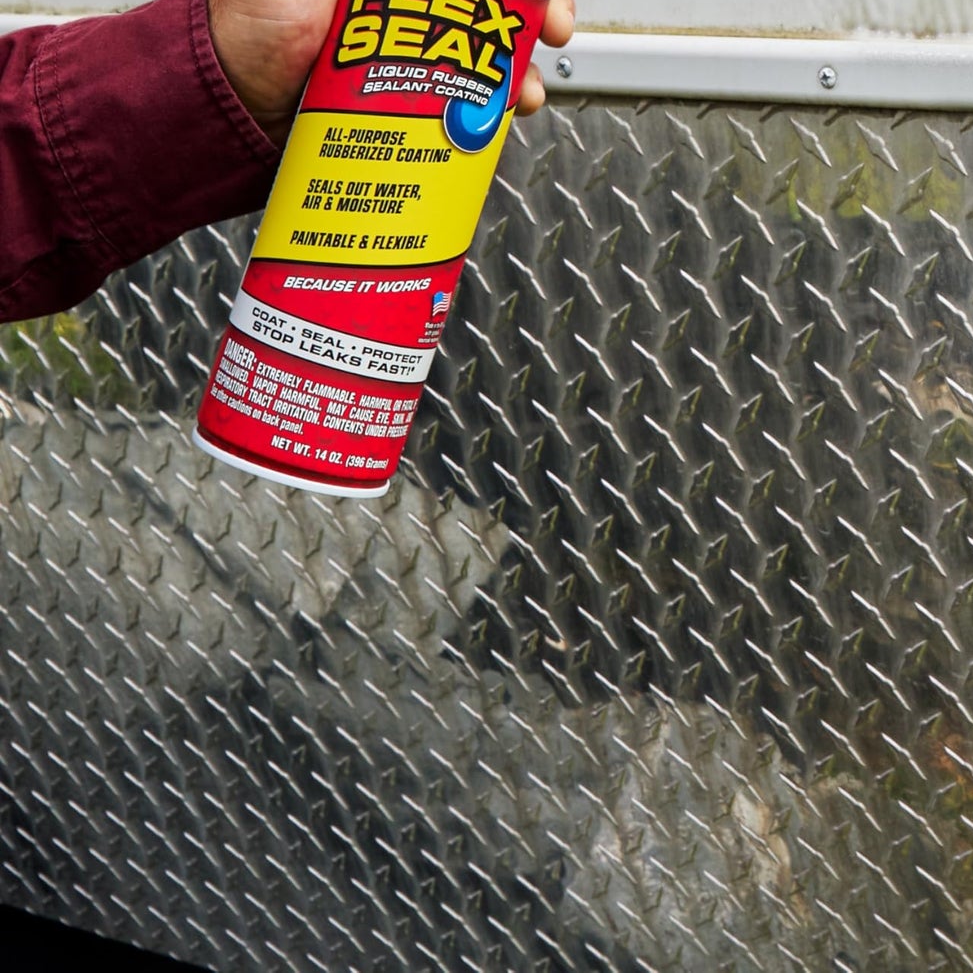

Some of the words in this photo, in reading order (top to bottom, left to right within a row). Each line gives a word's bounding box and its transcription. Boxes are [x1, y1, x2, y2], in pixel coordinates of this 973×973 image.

[337, 13, 504, 83] SEAL
[363, 80, 432, 94] SEALANT
[434, 84, 489, 106] COATING
[367, 65, 428, 79] LIQUID
[431, 70, 493, 97] RUBBER
[324, 127, 407, 146] ALL-PURPOSE
[319, 143, 394, 162] RUBBERIZED
[396, 148, 452, 163] COATING
[301, 195, 323, 210] AIR
[324, 197, 332, 210] &
[336, 197, 405, 214] MOISTURE
[307, 178, 343, 195] SEALS
[345, 181, 372, 197] OUT
[374, 183, 421, 201] WATER,
[290, 230, 357, 248] PAINTABLE
[358, 235, 369, 249] &
[372, 235, 428, 250] FLEXIBLE
[282, 276, 355, 292] BECAUSE
[357, 281, 375, 293] IT
[375, 277, 432, 293] WORKS
[252, 306, 287, 329] COAT
[301, 328, 345, 349] SEAL
[362, 345, 423, 364] PROTECT
[252, 321, 294, 344] STOP
[299, 340, 363, 367] LEAKS
[224, 338, 257, 371] DANGER:
[256, 362, 302, 388] EXTREMELY
[303, 379, 356, 404] FLAMMABLE.
[359, 395, 392, 411] HARMFUL
[248, 388, 273, 409] TRACT
[272, 399, 320, 425] IRRITATION.
[323, 414, 365, 435] CONTENTS
[365, 424, 387, 438] UNDER
[252, 375, 278, 396] VAPOR
[280, 388, 322, 411] HARMFUL.
[326, 401, 347, 416] MAY
[349, 406, 375, 422] CAUSE
[227, 396, 253, 416] cautions
[252, 408, 262, 420] on
[262, 410, 280, 427] back
[279, 420, 304, 435] panel.
[271, 435, 292, 451] NET
[293, 442, 311, 457] WT.
[315, 448, 327, 461] 14
[328, 450, 343, 465] OZ.
[345, 454, 365, 467] (396
